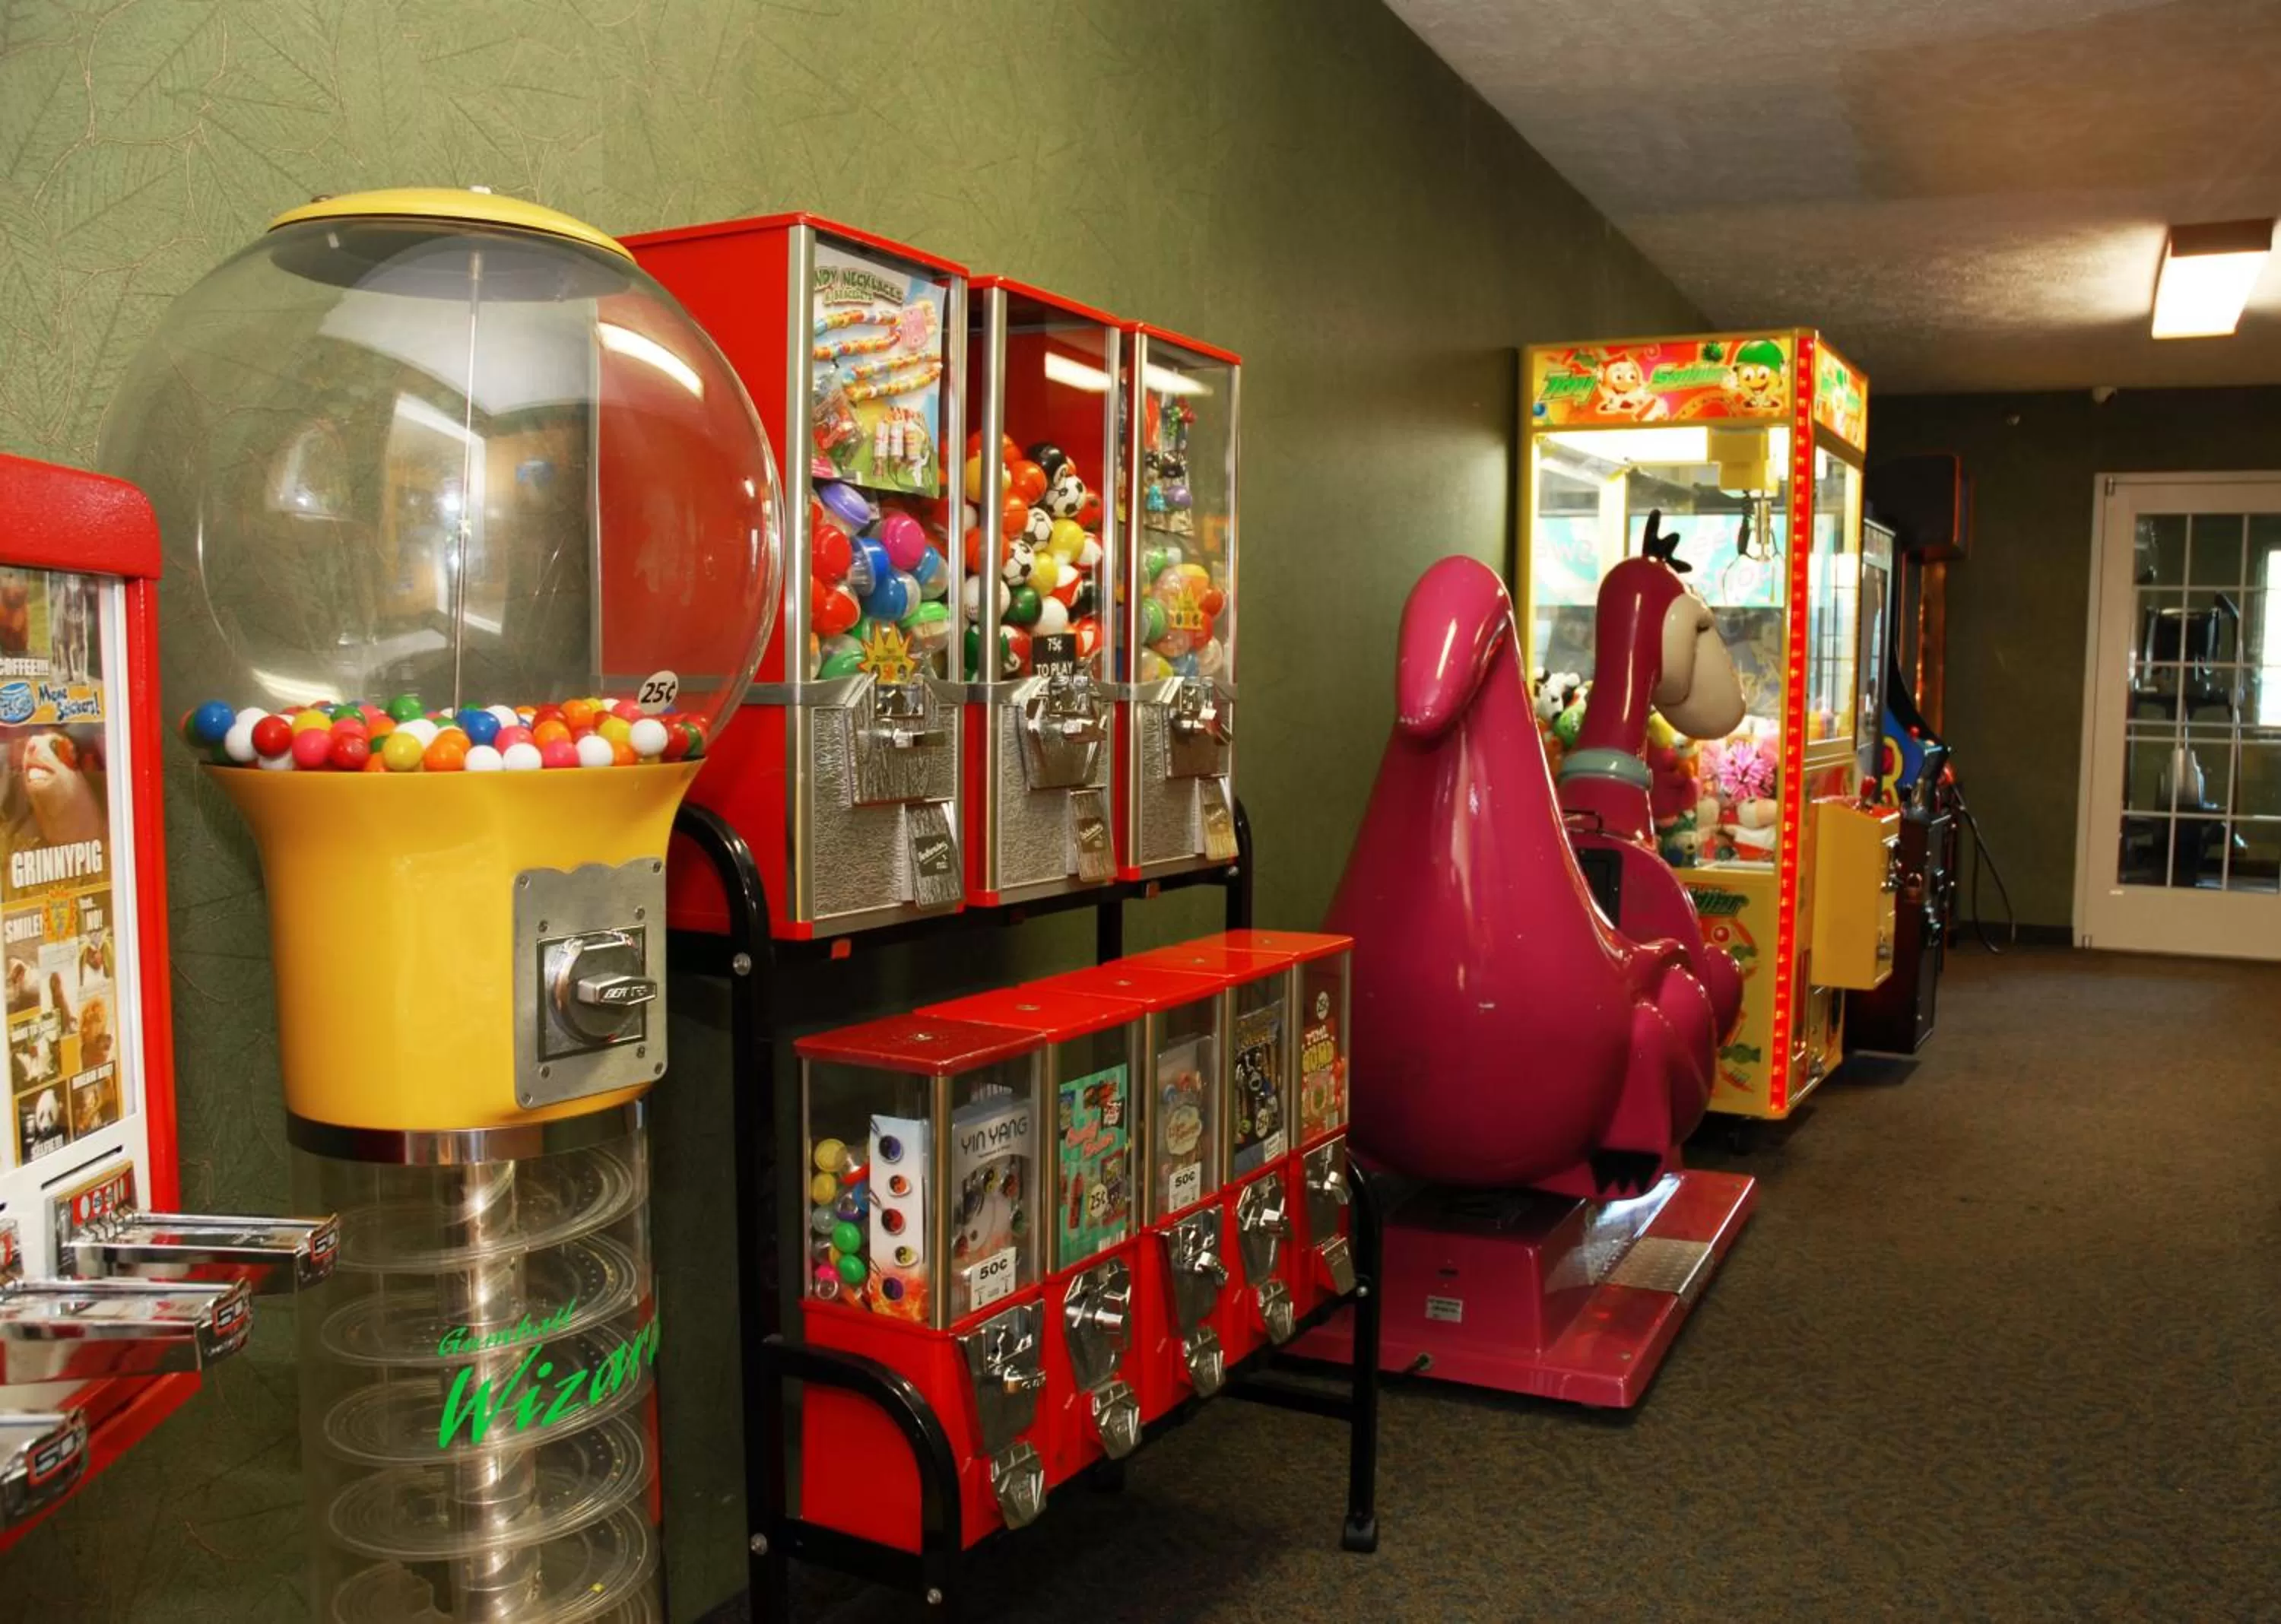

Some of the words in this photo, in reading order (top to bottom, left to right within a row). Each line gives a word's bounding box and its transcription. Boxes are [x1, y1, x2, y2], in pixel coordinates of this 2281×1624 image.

[1036, 663, 1049, 677] TO
[1050, 661, 1074, 677] PLAY
[641, 681, 676, 703] 25¢
[11, 839, 103, 889] GRINNYPIG
[5, 913, 43, 944] SMILE!
[960, 1130, 986, 1156] YIN
[988, 1115, 1028, 1144] YANG
